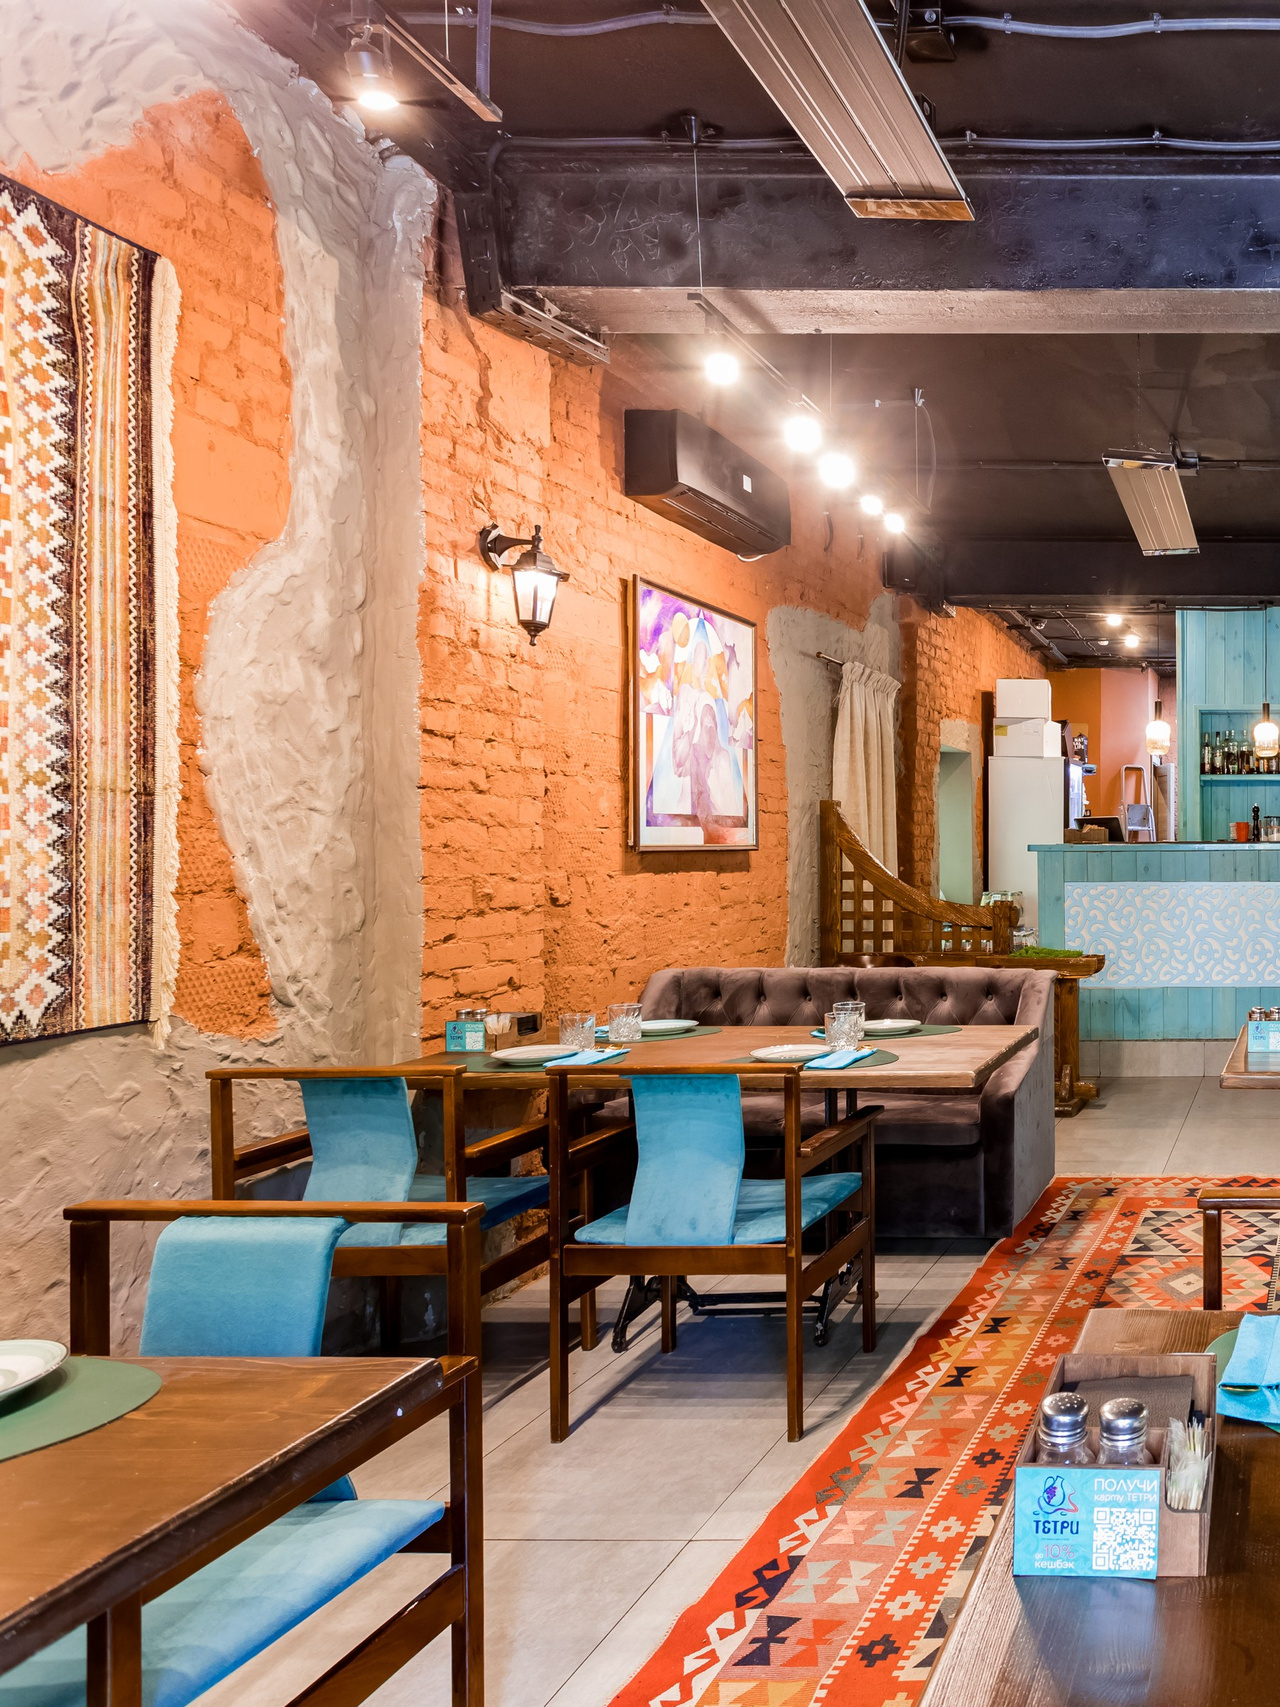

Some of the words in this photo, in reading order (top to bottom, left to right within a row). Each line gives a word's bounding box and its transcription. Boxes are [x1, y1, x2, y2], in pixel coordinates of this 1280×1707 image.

[1094, 1478, 1158, 1492] ПОЛУЧИ
[1126, 1492, 1158, 1502] ТЕТРИ
[1044, 1543, 1075, 1559] 10%
[1034, 1559, 1075, 1569] кешбэк
